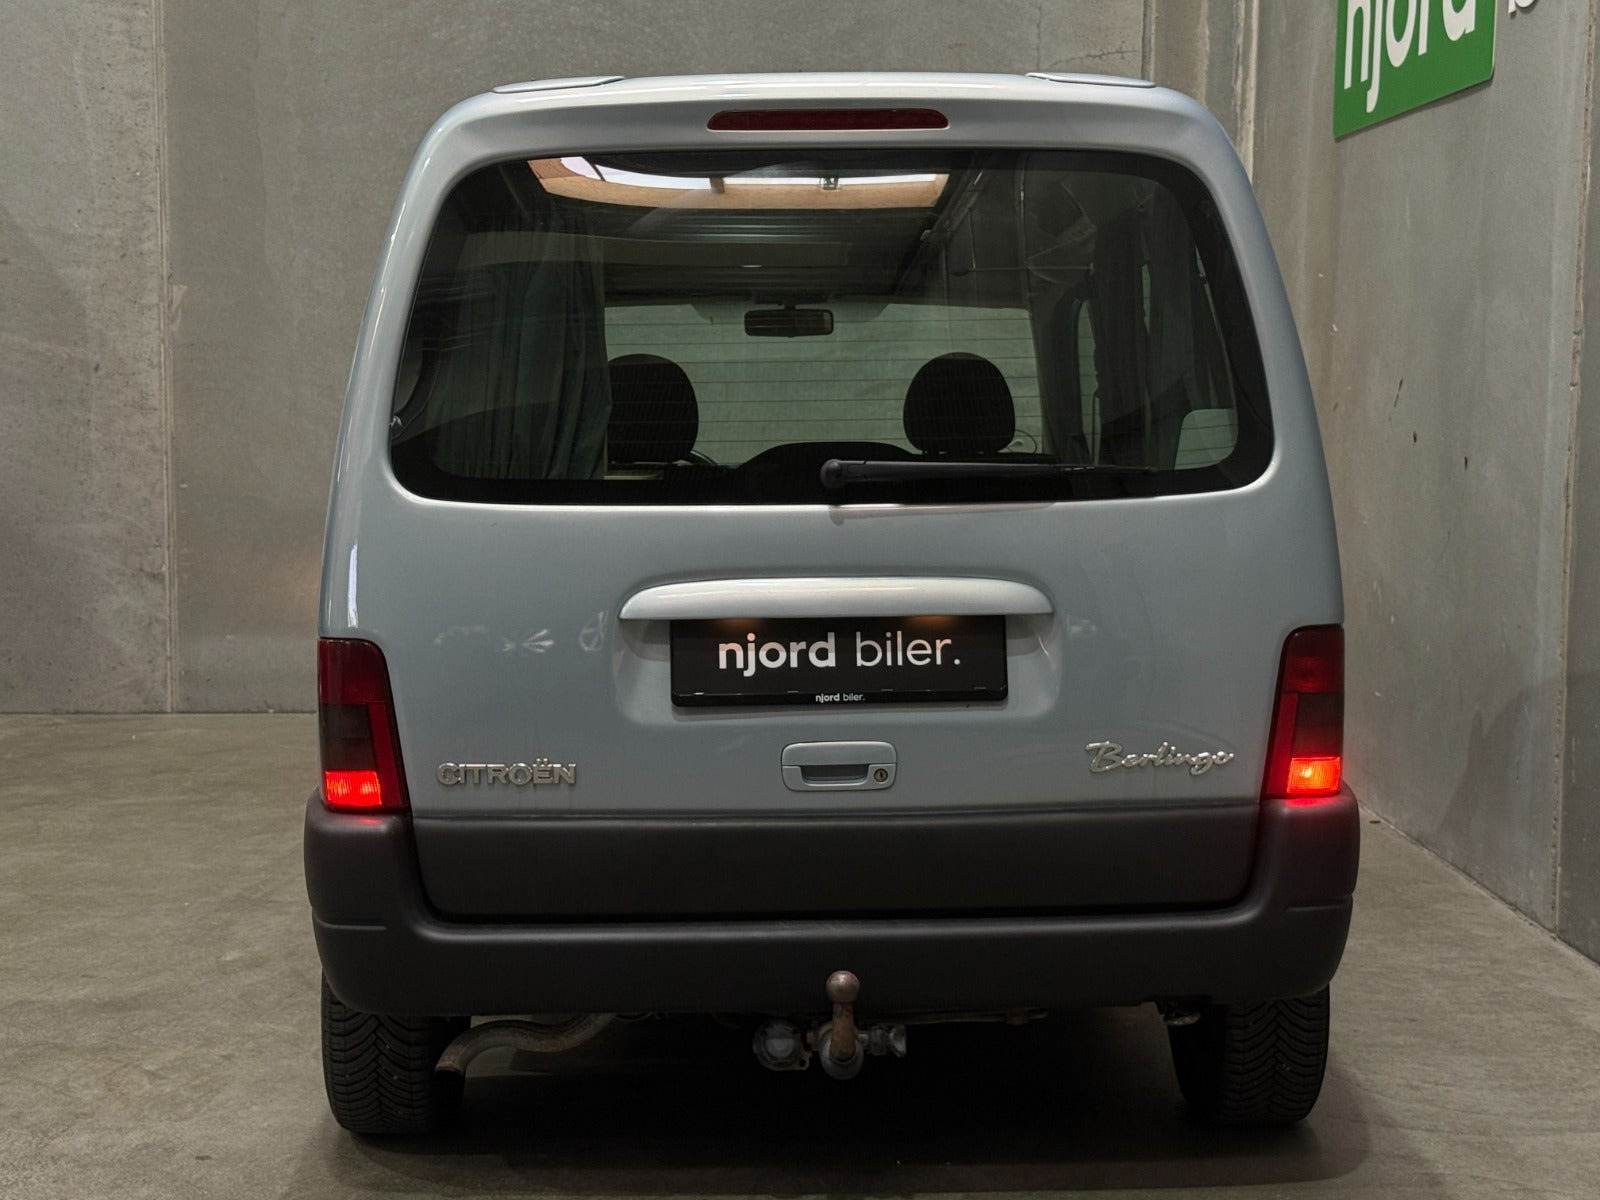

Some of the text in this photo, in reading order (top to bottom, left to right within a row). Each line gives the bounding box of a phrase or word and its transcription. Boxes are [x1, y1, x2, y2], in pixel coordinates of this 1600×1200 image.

[1344, 0, 1476, 113] njo
[717, 630, 961, 677] njord biler.
[815, 692, 866, 703] njord biler.
[437, 757, 577, 785] CITROËN
[1085, 740, 1234, 775] Berlingo
